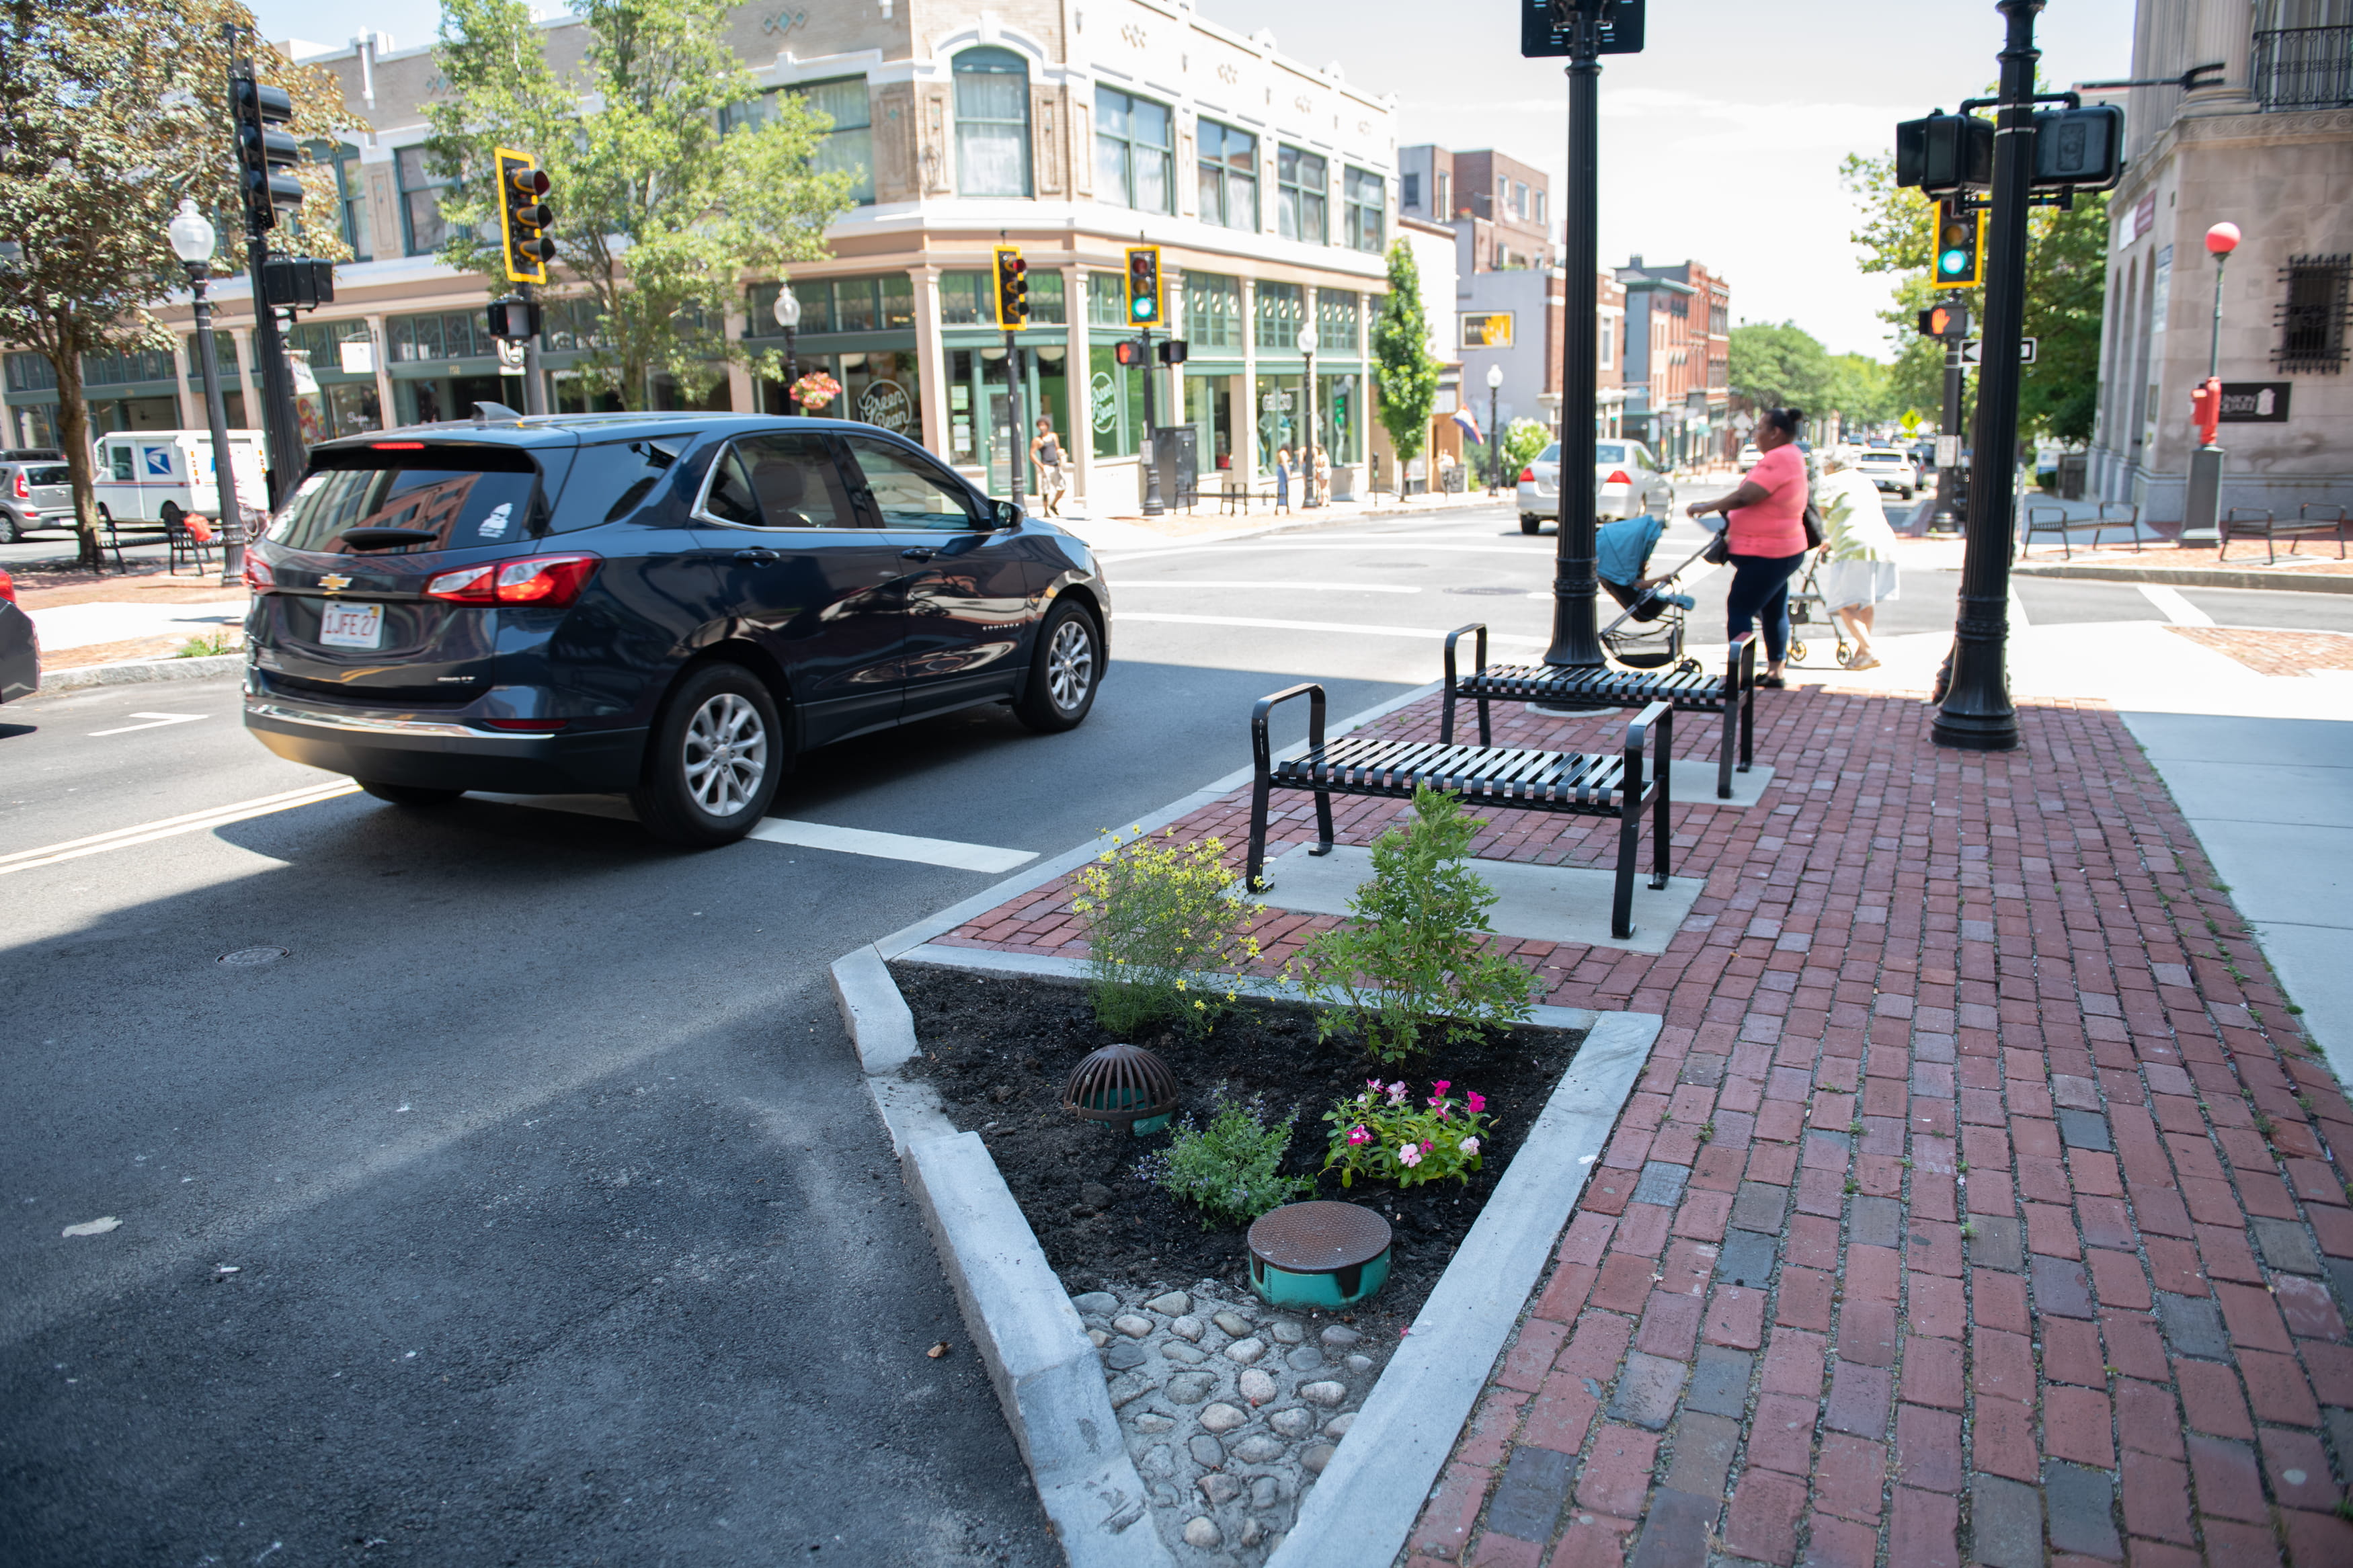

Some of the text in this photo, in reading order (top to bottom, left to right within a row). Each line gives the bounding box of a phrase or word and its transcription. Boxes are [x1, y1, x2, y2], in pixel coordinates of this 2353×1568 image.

[857, 390, 905, 417] Green
[2221, 394, 2256, 404] NION
[2220, 402, 2255, 413] QUARE
[360, 615, 379, 636] 27
